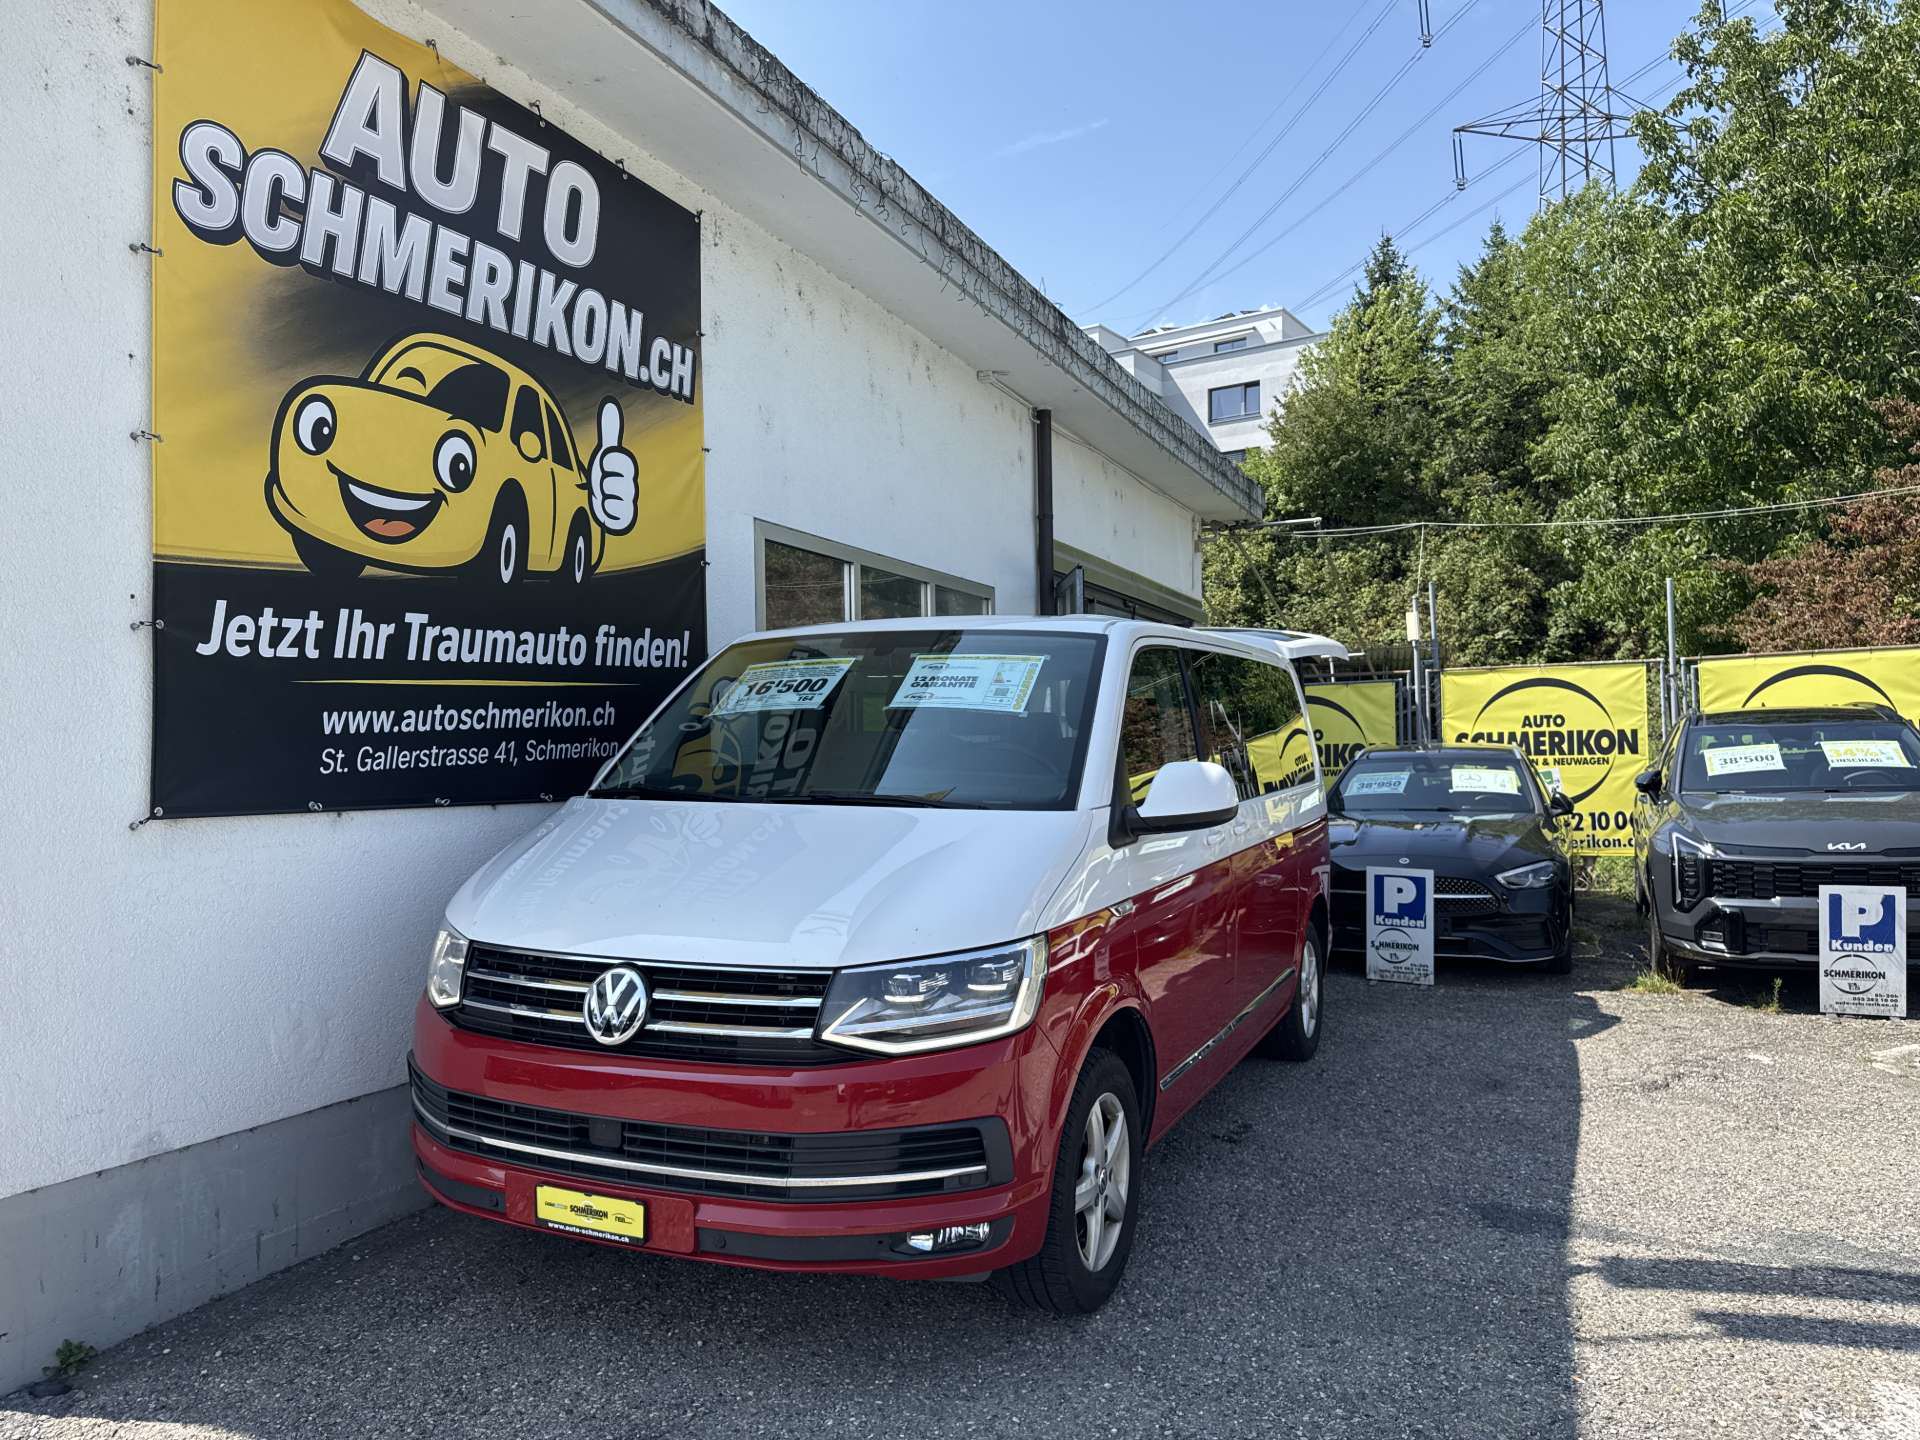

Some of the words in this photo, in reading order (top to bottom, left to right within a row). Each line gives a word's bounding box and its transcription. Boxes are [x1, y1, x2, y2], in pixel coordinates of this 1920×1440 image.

[321, 51, 600, 269] AUTO
[174, 121, 696, 400] SCHMERIKON.CH
[196, 599, 324, 658] Jetzt
[334, 608, 396, 660] Ihr
[405, 612, 587, 666] Traumauto
[595, 625, 690, 668] finden!
[746, 678, 829, 697] 16'500
[910, 681, 977, 689] GARANTIE
[322, 701, 616, 735] www.autoschmerikon.ch
[1521, 715, 1565, 729] AUTO
[319, 748, 349, 775] St.
[356, 745, 489, 772] Gallerstrasse
[494, 741, 518, 767] 41,
[525, 737, 619, 762] Schmerikon
[1553, 756, 1610, 766] NEUWAGEN
[1719, 754, 1775, 765] 38'500
[1588, 811, 1610, 831] 10
[1384, 876, 1417, 914] P
[1375, 915, 1425, 927] Kunden
[1841, 893, 1884, 937] P
[1831, 940, 1894, 953] Kunden
[1823, 969, 1886, 979] SCHMERIKON
[569, 1204, 609, 1219] SCHMERIKON
[547, 1222, 630, 1243] www.auto-schmerikon.ch
